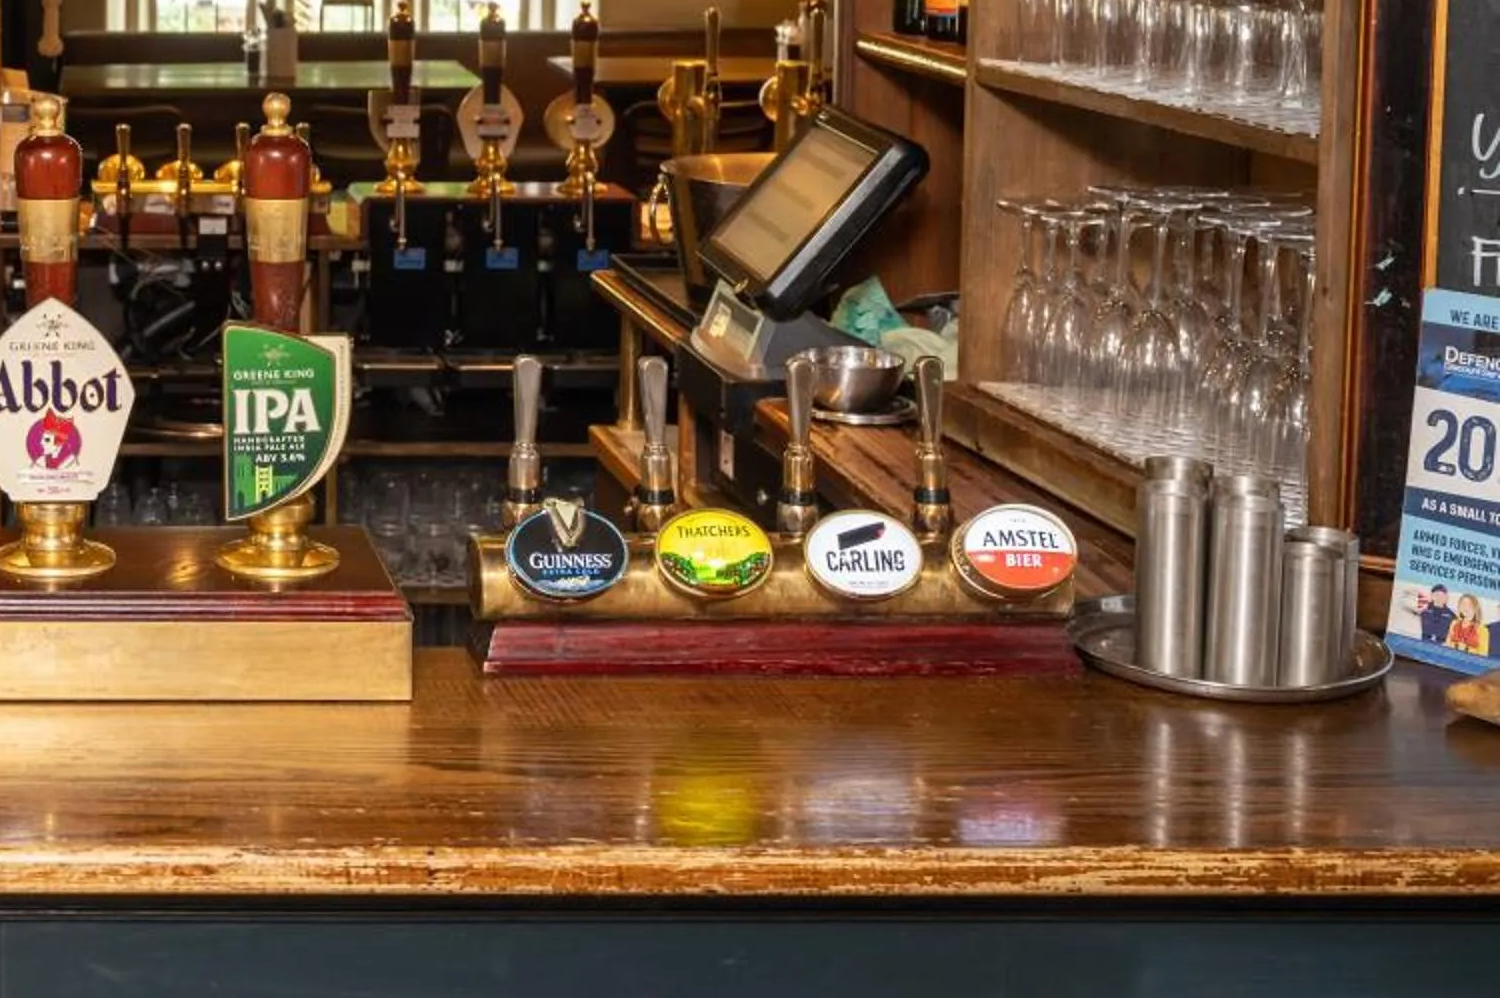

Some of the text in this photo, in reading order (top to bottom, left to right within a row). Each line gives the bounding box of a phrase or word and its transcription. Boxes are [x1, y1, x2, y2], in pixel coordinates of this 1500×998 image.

[1450, 309, 1499, 330] WE ARE
[9, 340, 97, 351] GREENE KING
[233, 368, 315, 382] GREENE KING
[233, 388, 321, 435] IPA
[1421, 497, 1437, 512] AS
[1439, 502, 1447, 514] A
[1450, 504, 1487, 523] SMALL
[676, 525, 751, 539] THATCHERS
[983, 529, 1060, 549] AMSTEL
[1413, 529, 1447, 547] ARMED
[529, 551, 613, 570] GUINNESS
[1005, 553, 1043, 568] BIER
[1411, 543, 1433, 560] NHS
[825, 550, 906, 573] CARLING
[1409, 559, 1455, 580] SERVICES
